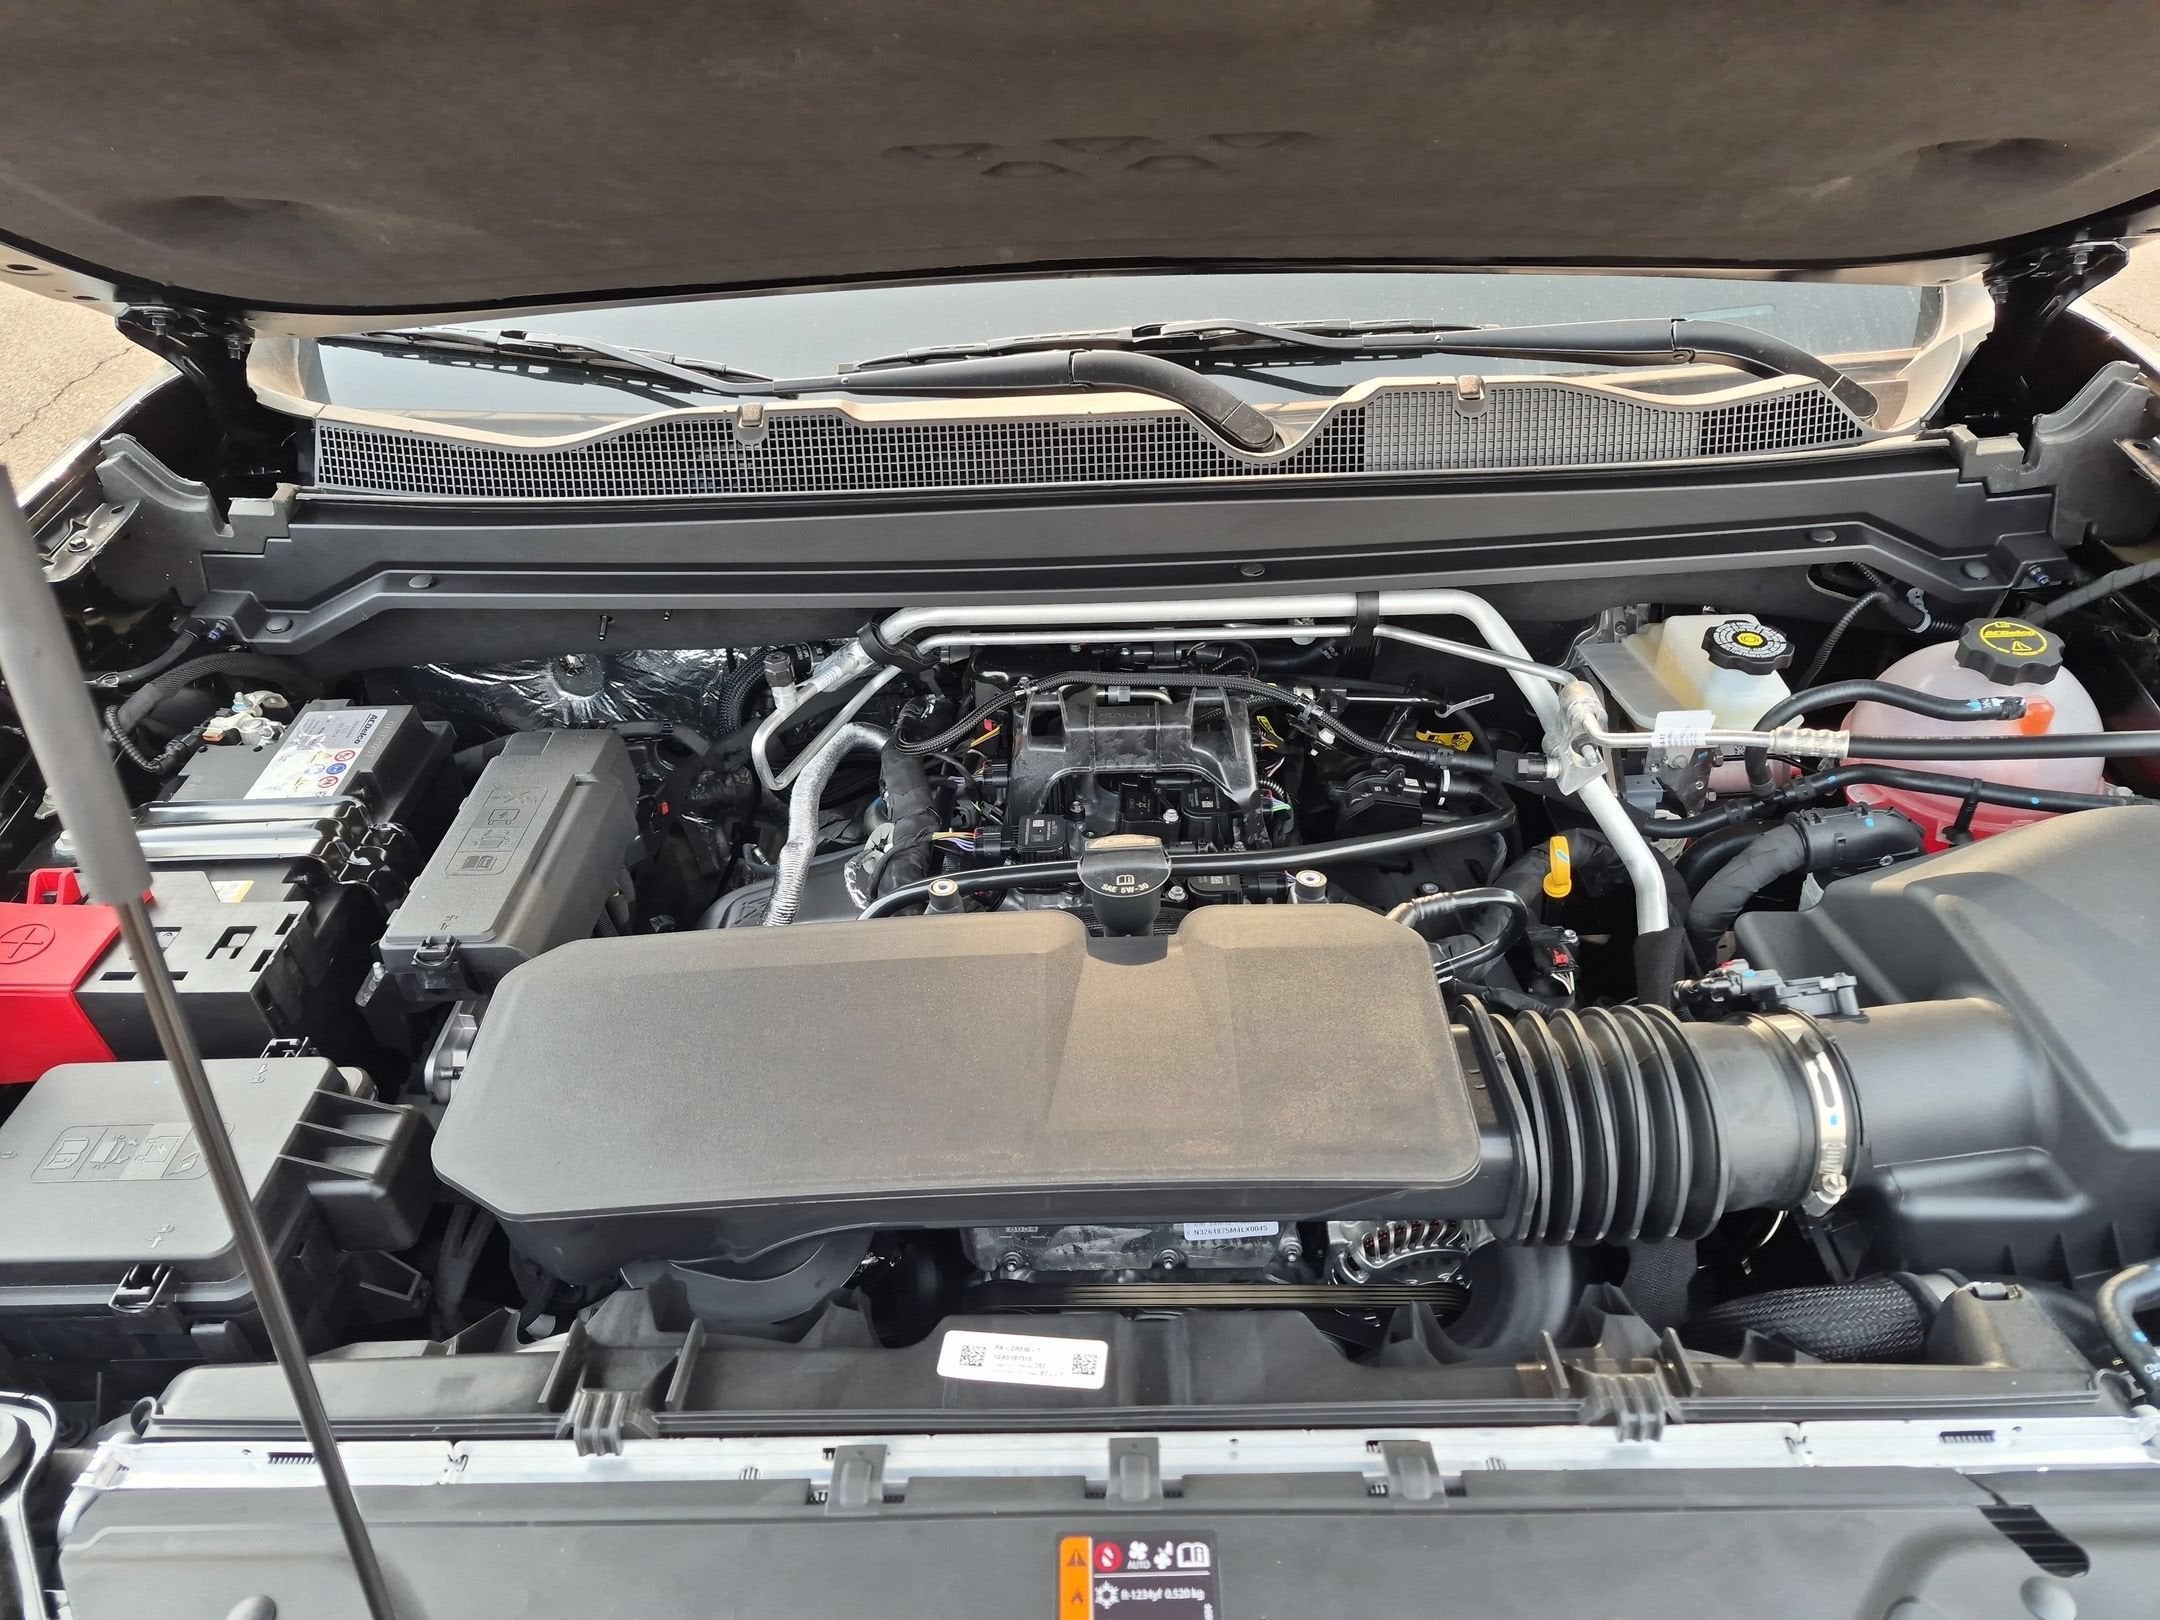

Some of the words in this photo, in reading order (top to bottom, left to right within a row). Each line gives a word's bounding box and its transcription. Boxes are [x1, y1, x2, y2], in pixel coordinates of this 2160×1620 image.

[354, 714, 378, 744] ACDelco
[1101, 883, 1118, 893] SAE
[1120, 882, 1150, 894] 5W-30
[1127, 1560, 1152, 1569] AUTO
[1192, 1587, 1205, 1601] kg
